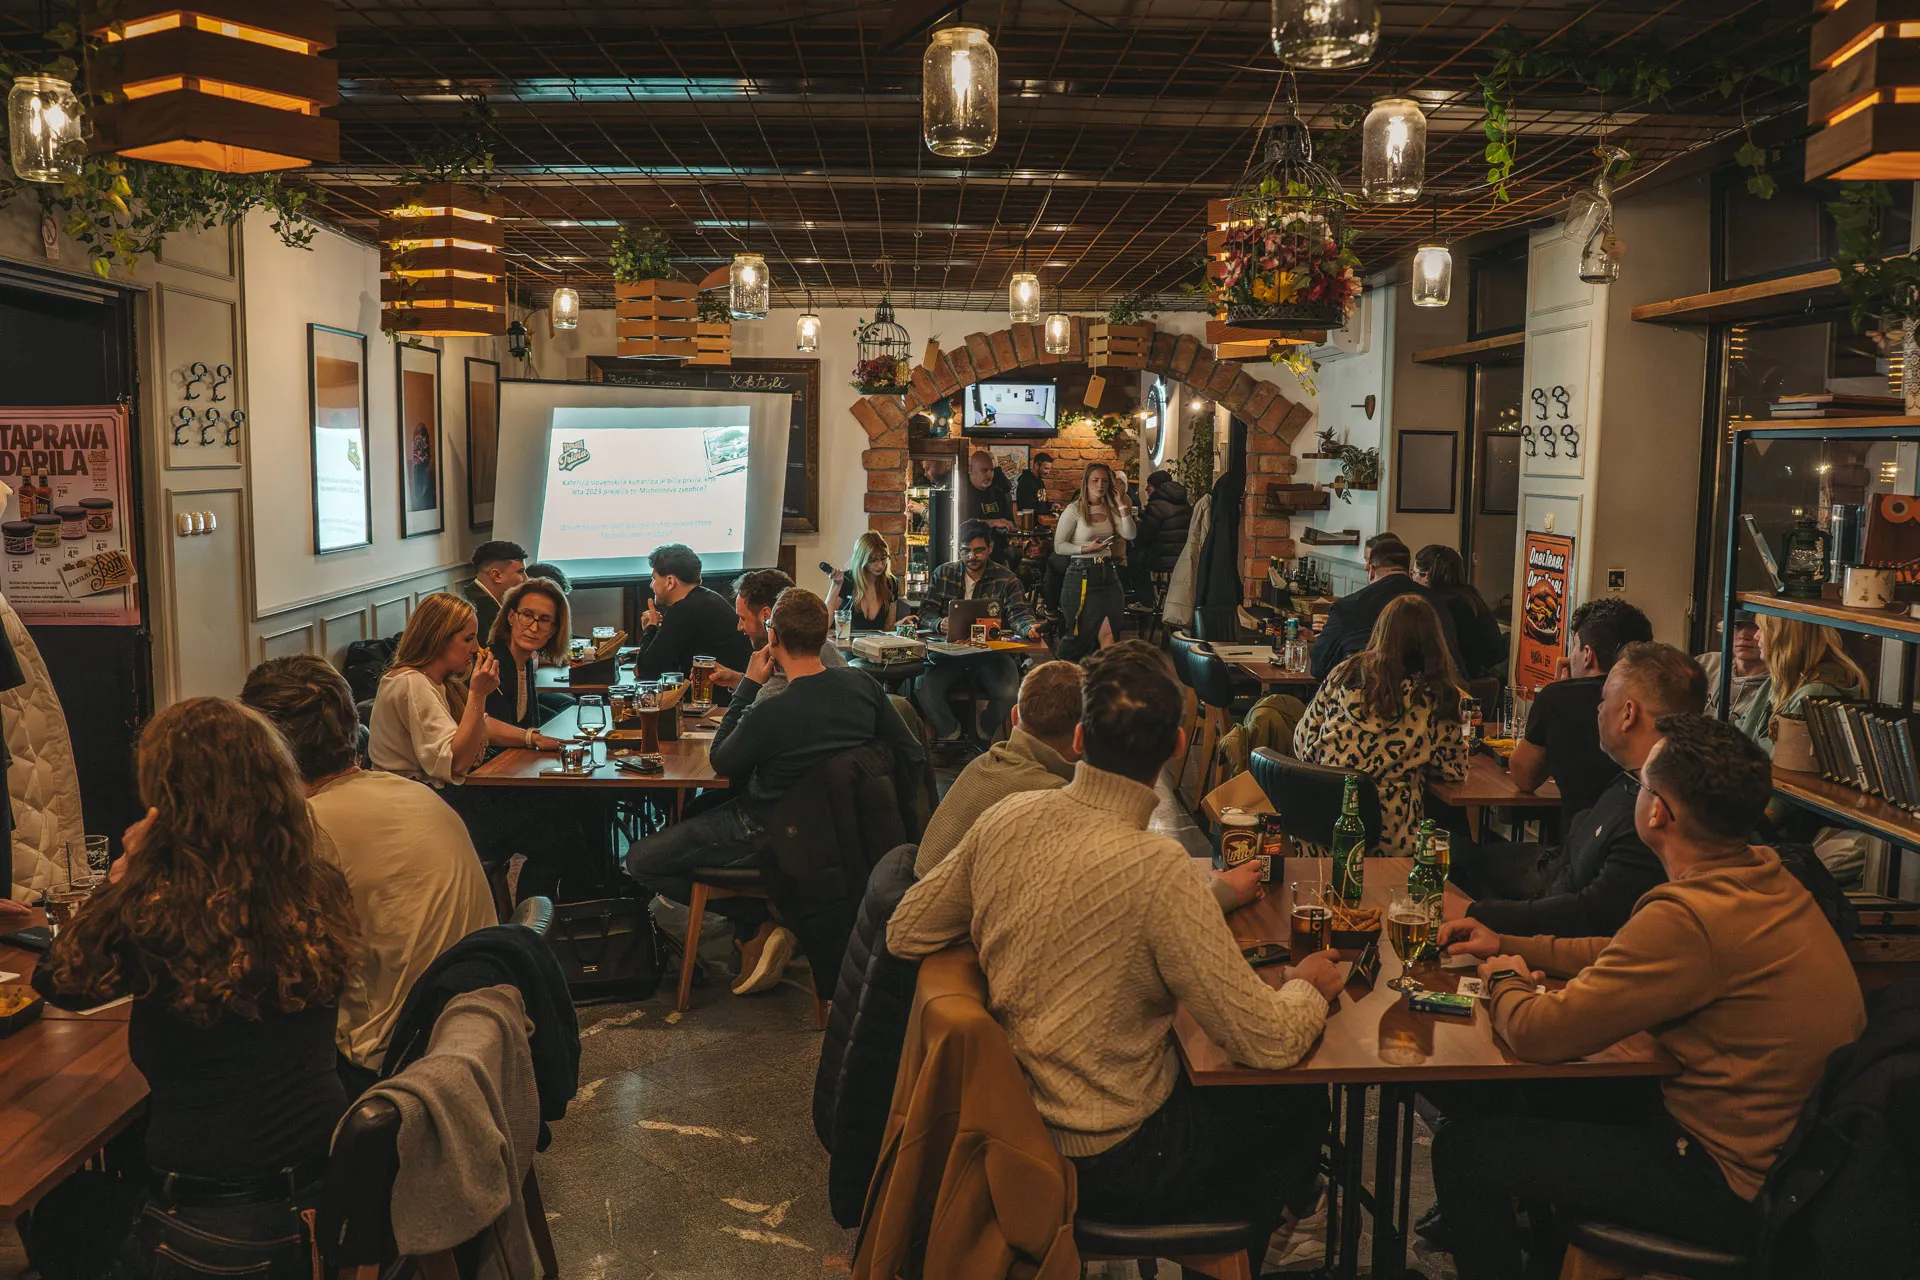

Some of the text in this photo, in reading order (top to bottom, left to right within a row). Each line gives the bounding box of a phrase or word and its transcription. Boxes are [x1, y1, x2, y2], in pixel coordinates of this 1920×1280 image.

[0, 424, 109, 450] TAPRAVA
[0, 450, 89, 476] DARILA
[727, 528, 733, 536] 2
